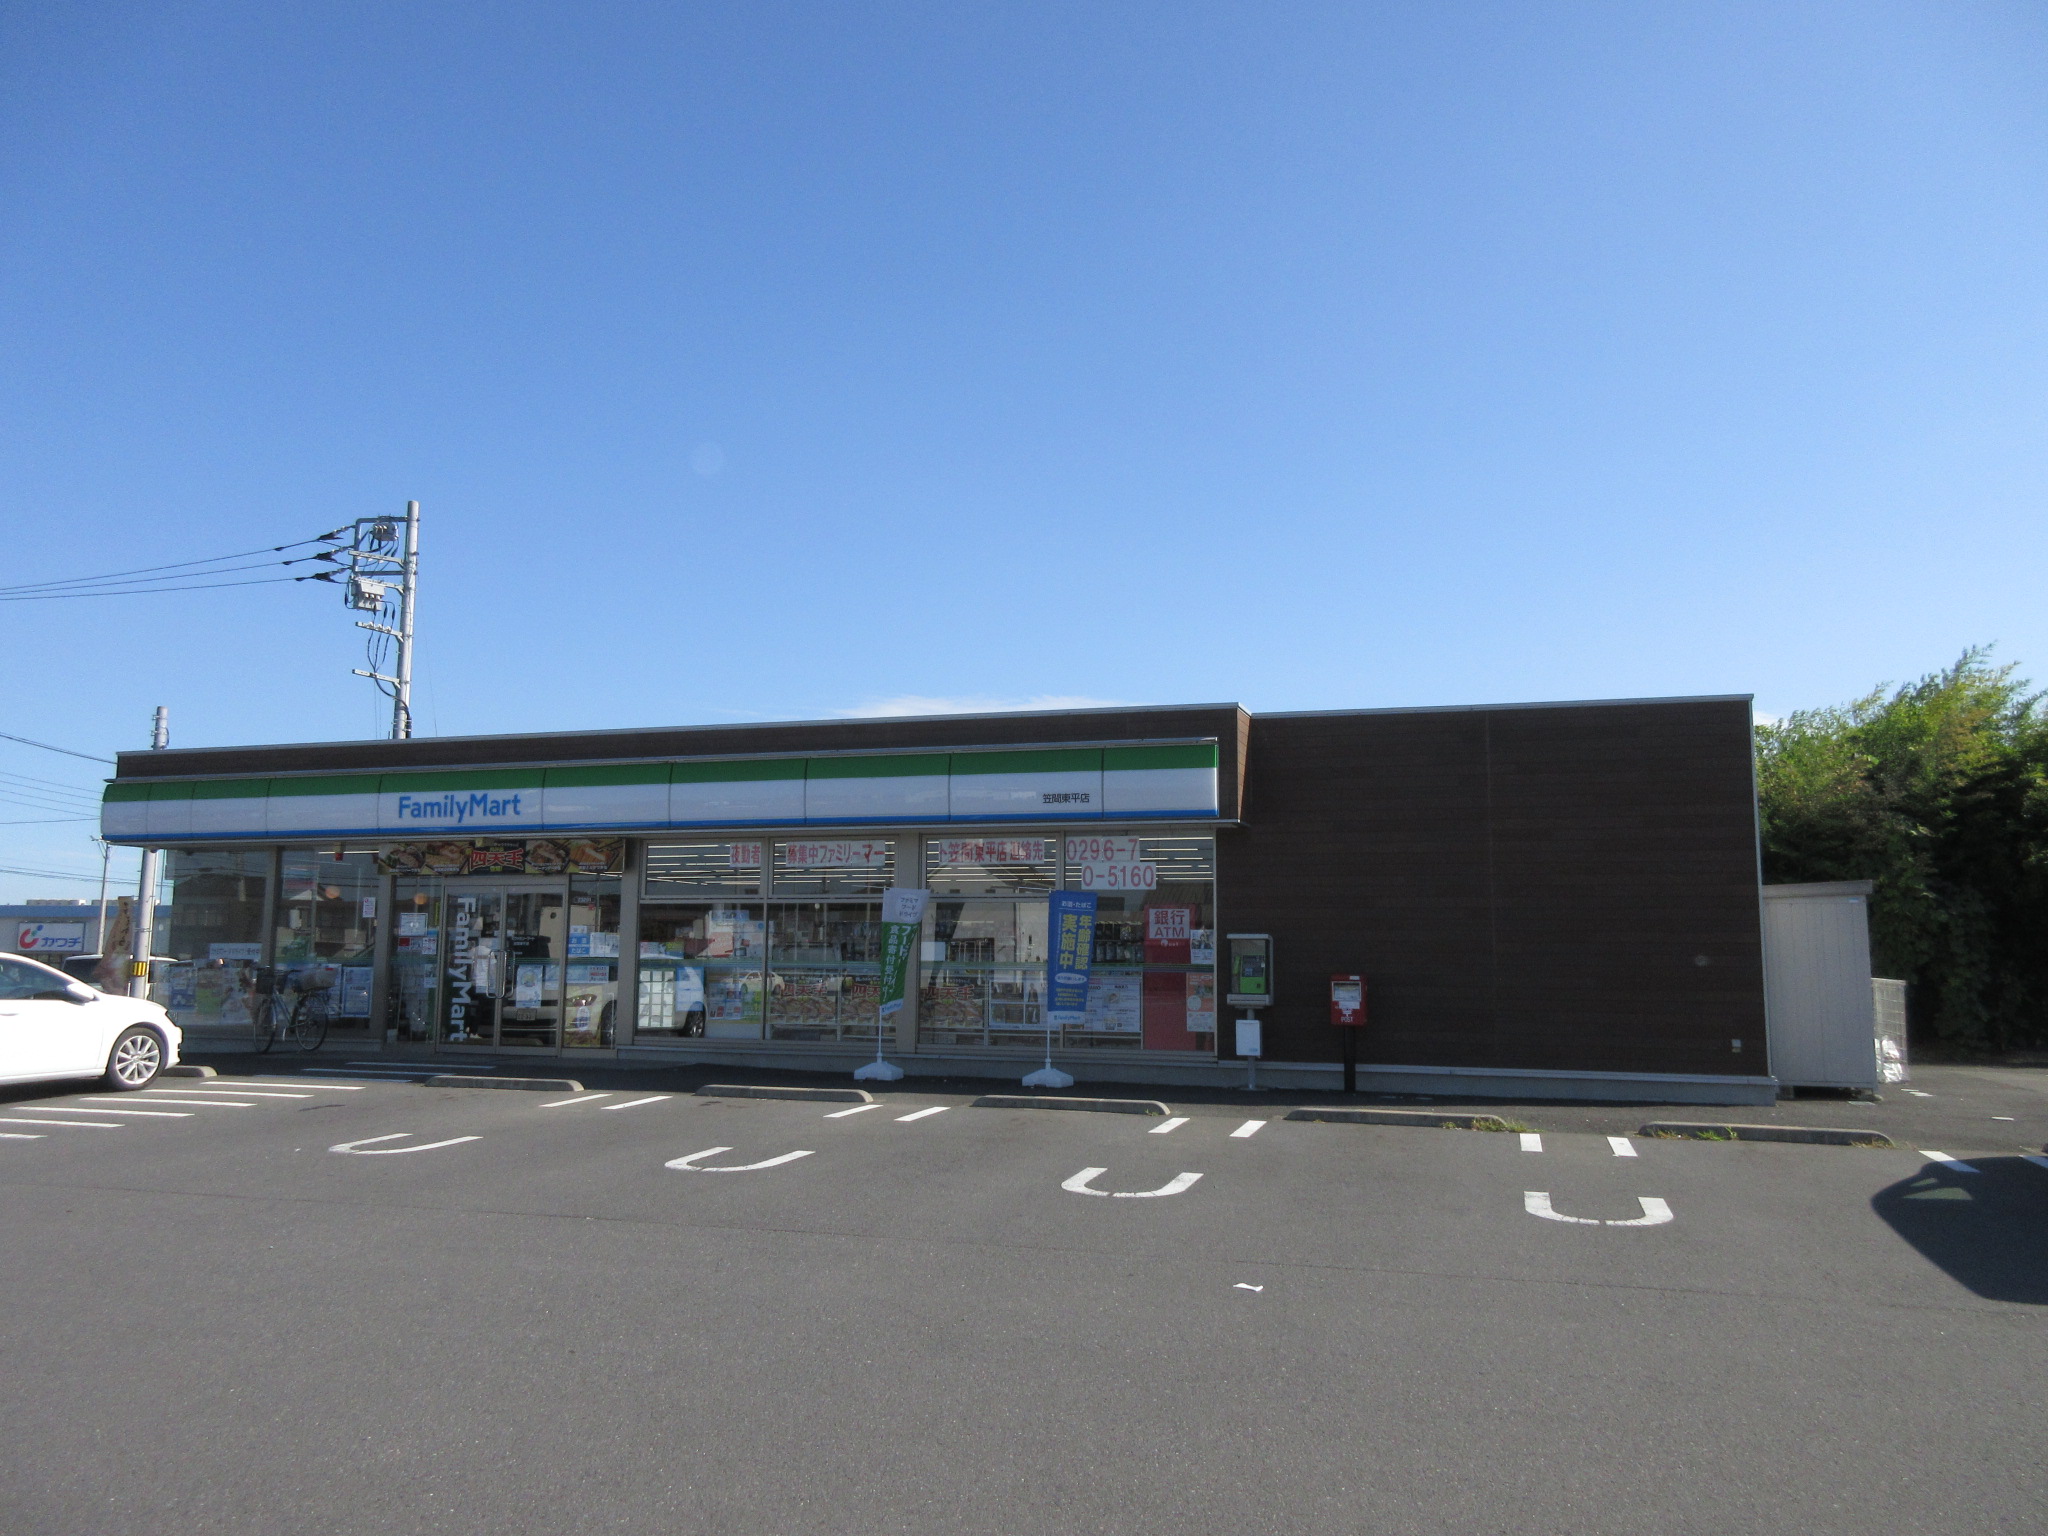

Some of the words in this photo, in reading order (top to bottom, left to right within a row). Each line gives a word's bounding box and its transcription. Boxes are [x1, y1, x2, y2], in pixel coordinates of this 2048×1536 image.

[398, 793, 521, 824] FamilyMart
[1042, 792, 1090, 804] 笠間東平店
[471, 848, 525, 871] 四天王
[786, 842, 886, 865] 募集中ファミリーマー
[1066, 838, 1139, 861] 0296-7
[1082, 864, 1155, 888] 0-5160
[1154, 909, 1185, 925] 銀行
[41, 936, 81, 948] カワチ
[1059, 913, 1078, 970] 実施中
[1074, 914, 1093, 970] 年齢確認
[1154, 926, 1185, 938] ATM
[448, 897, 477, 1042] FamilyMart
